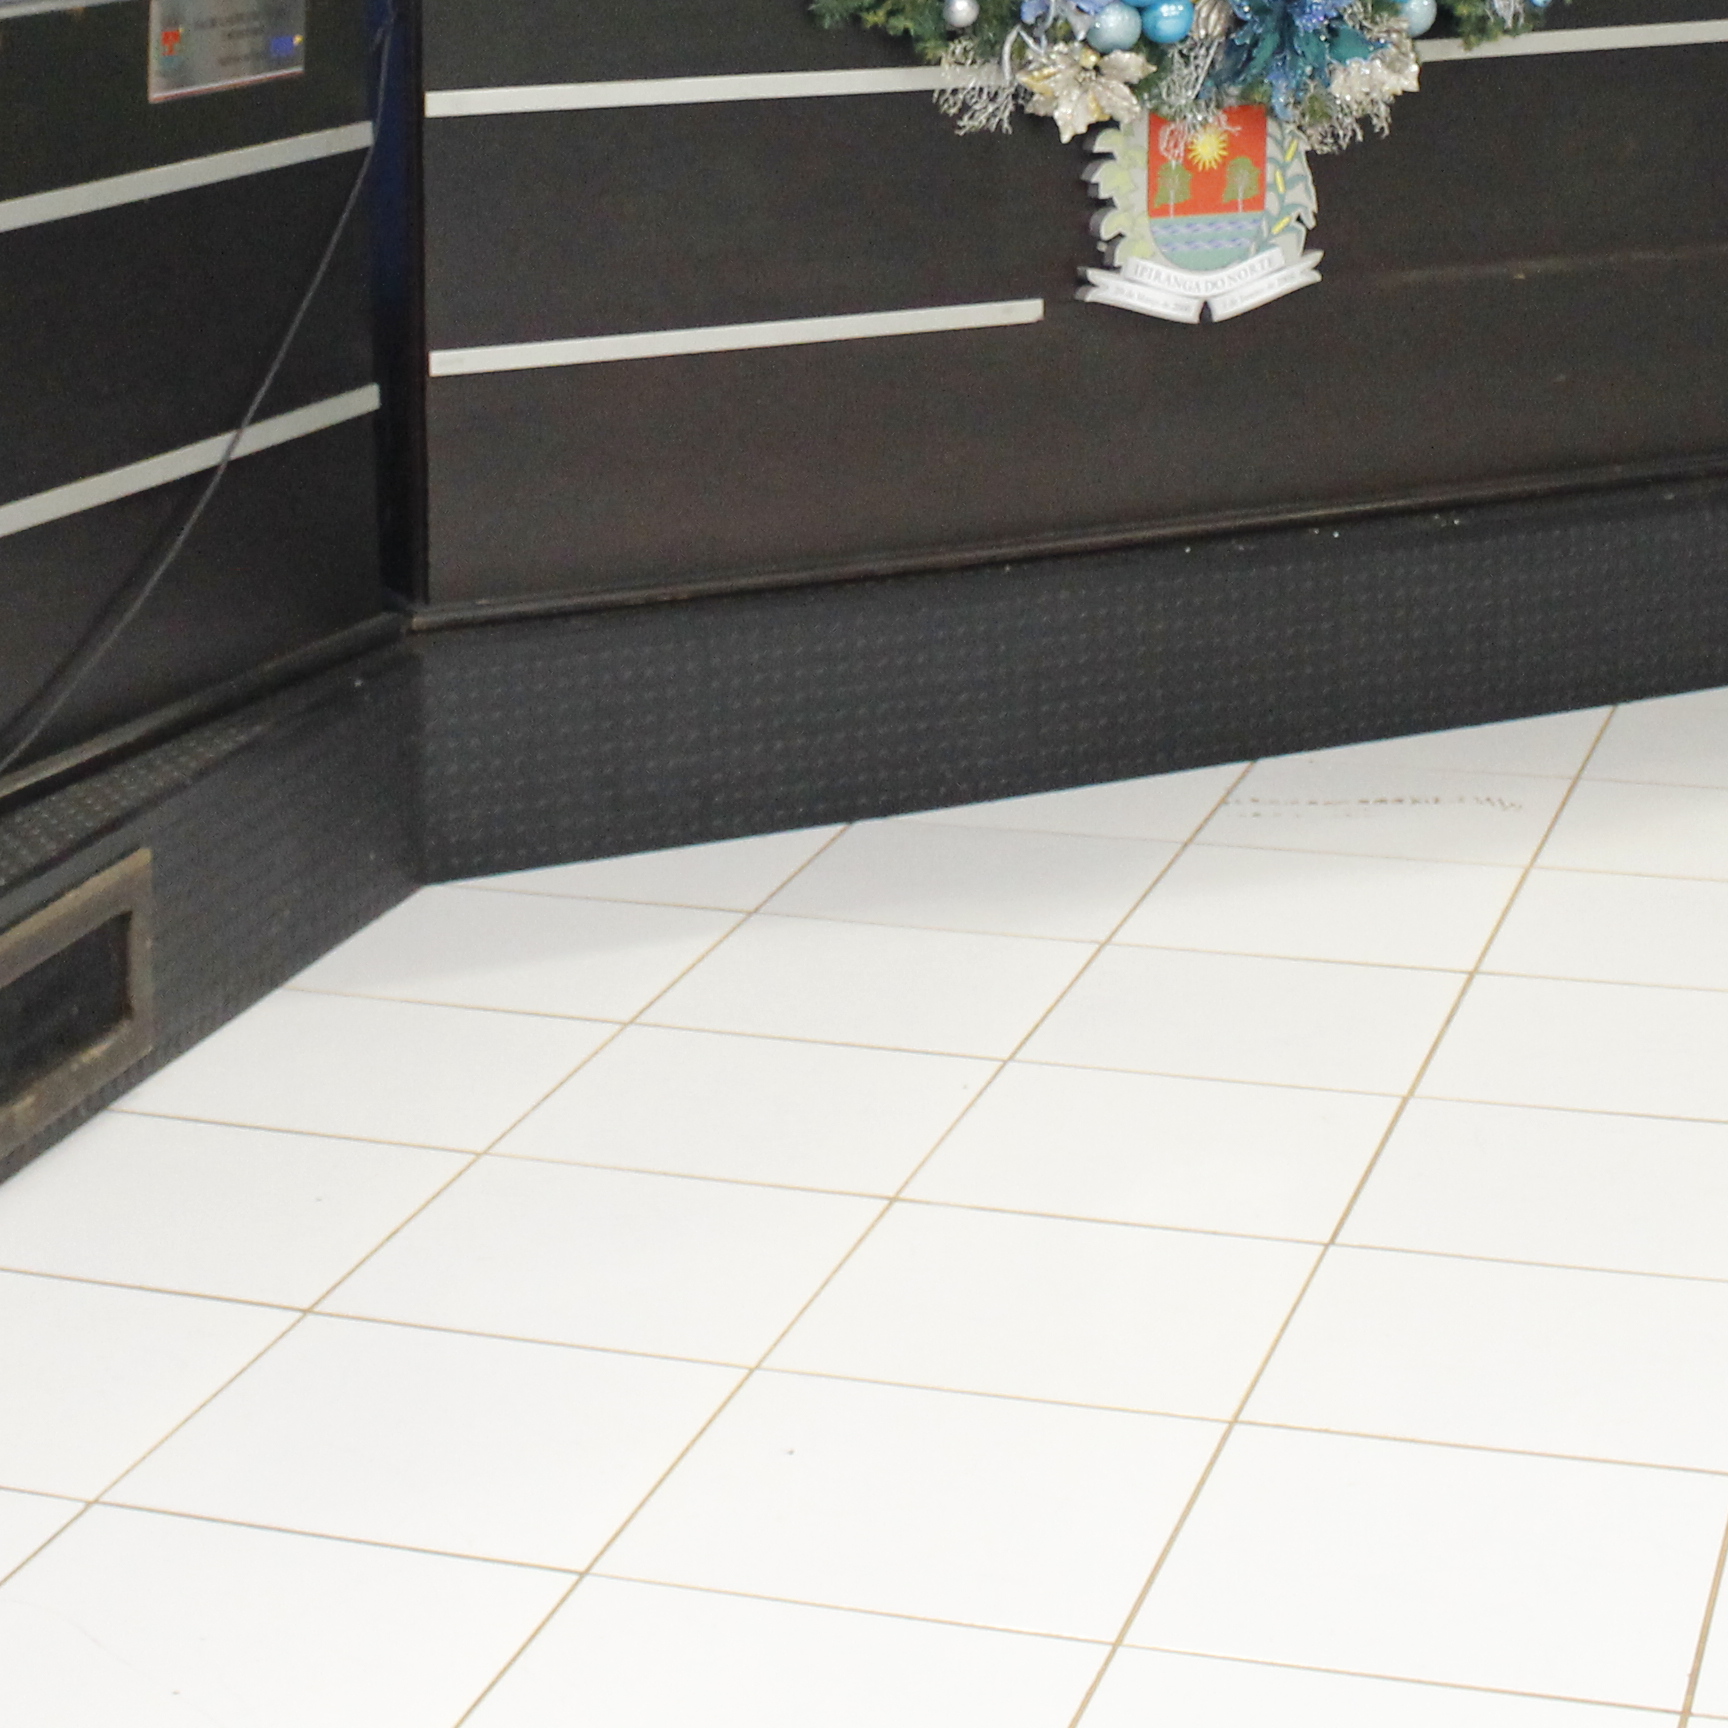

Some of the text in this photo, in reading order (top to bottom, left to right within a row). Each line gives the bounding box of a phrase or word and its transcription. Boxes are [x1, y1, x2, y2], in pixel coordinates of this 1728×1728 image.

[1132, 263, 1202, 293] IPIRANGA
[1204, 275, 1226, 292] DO
[1227, 256, 1274, 286] NORTE
